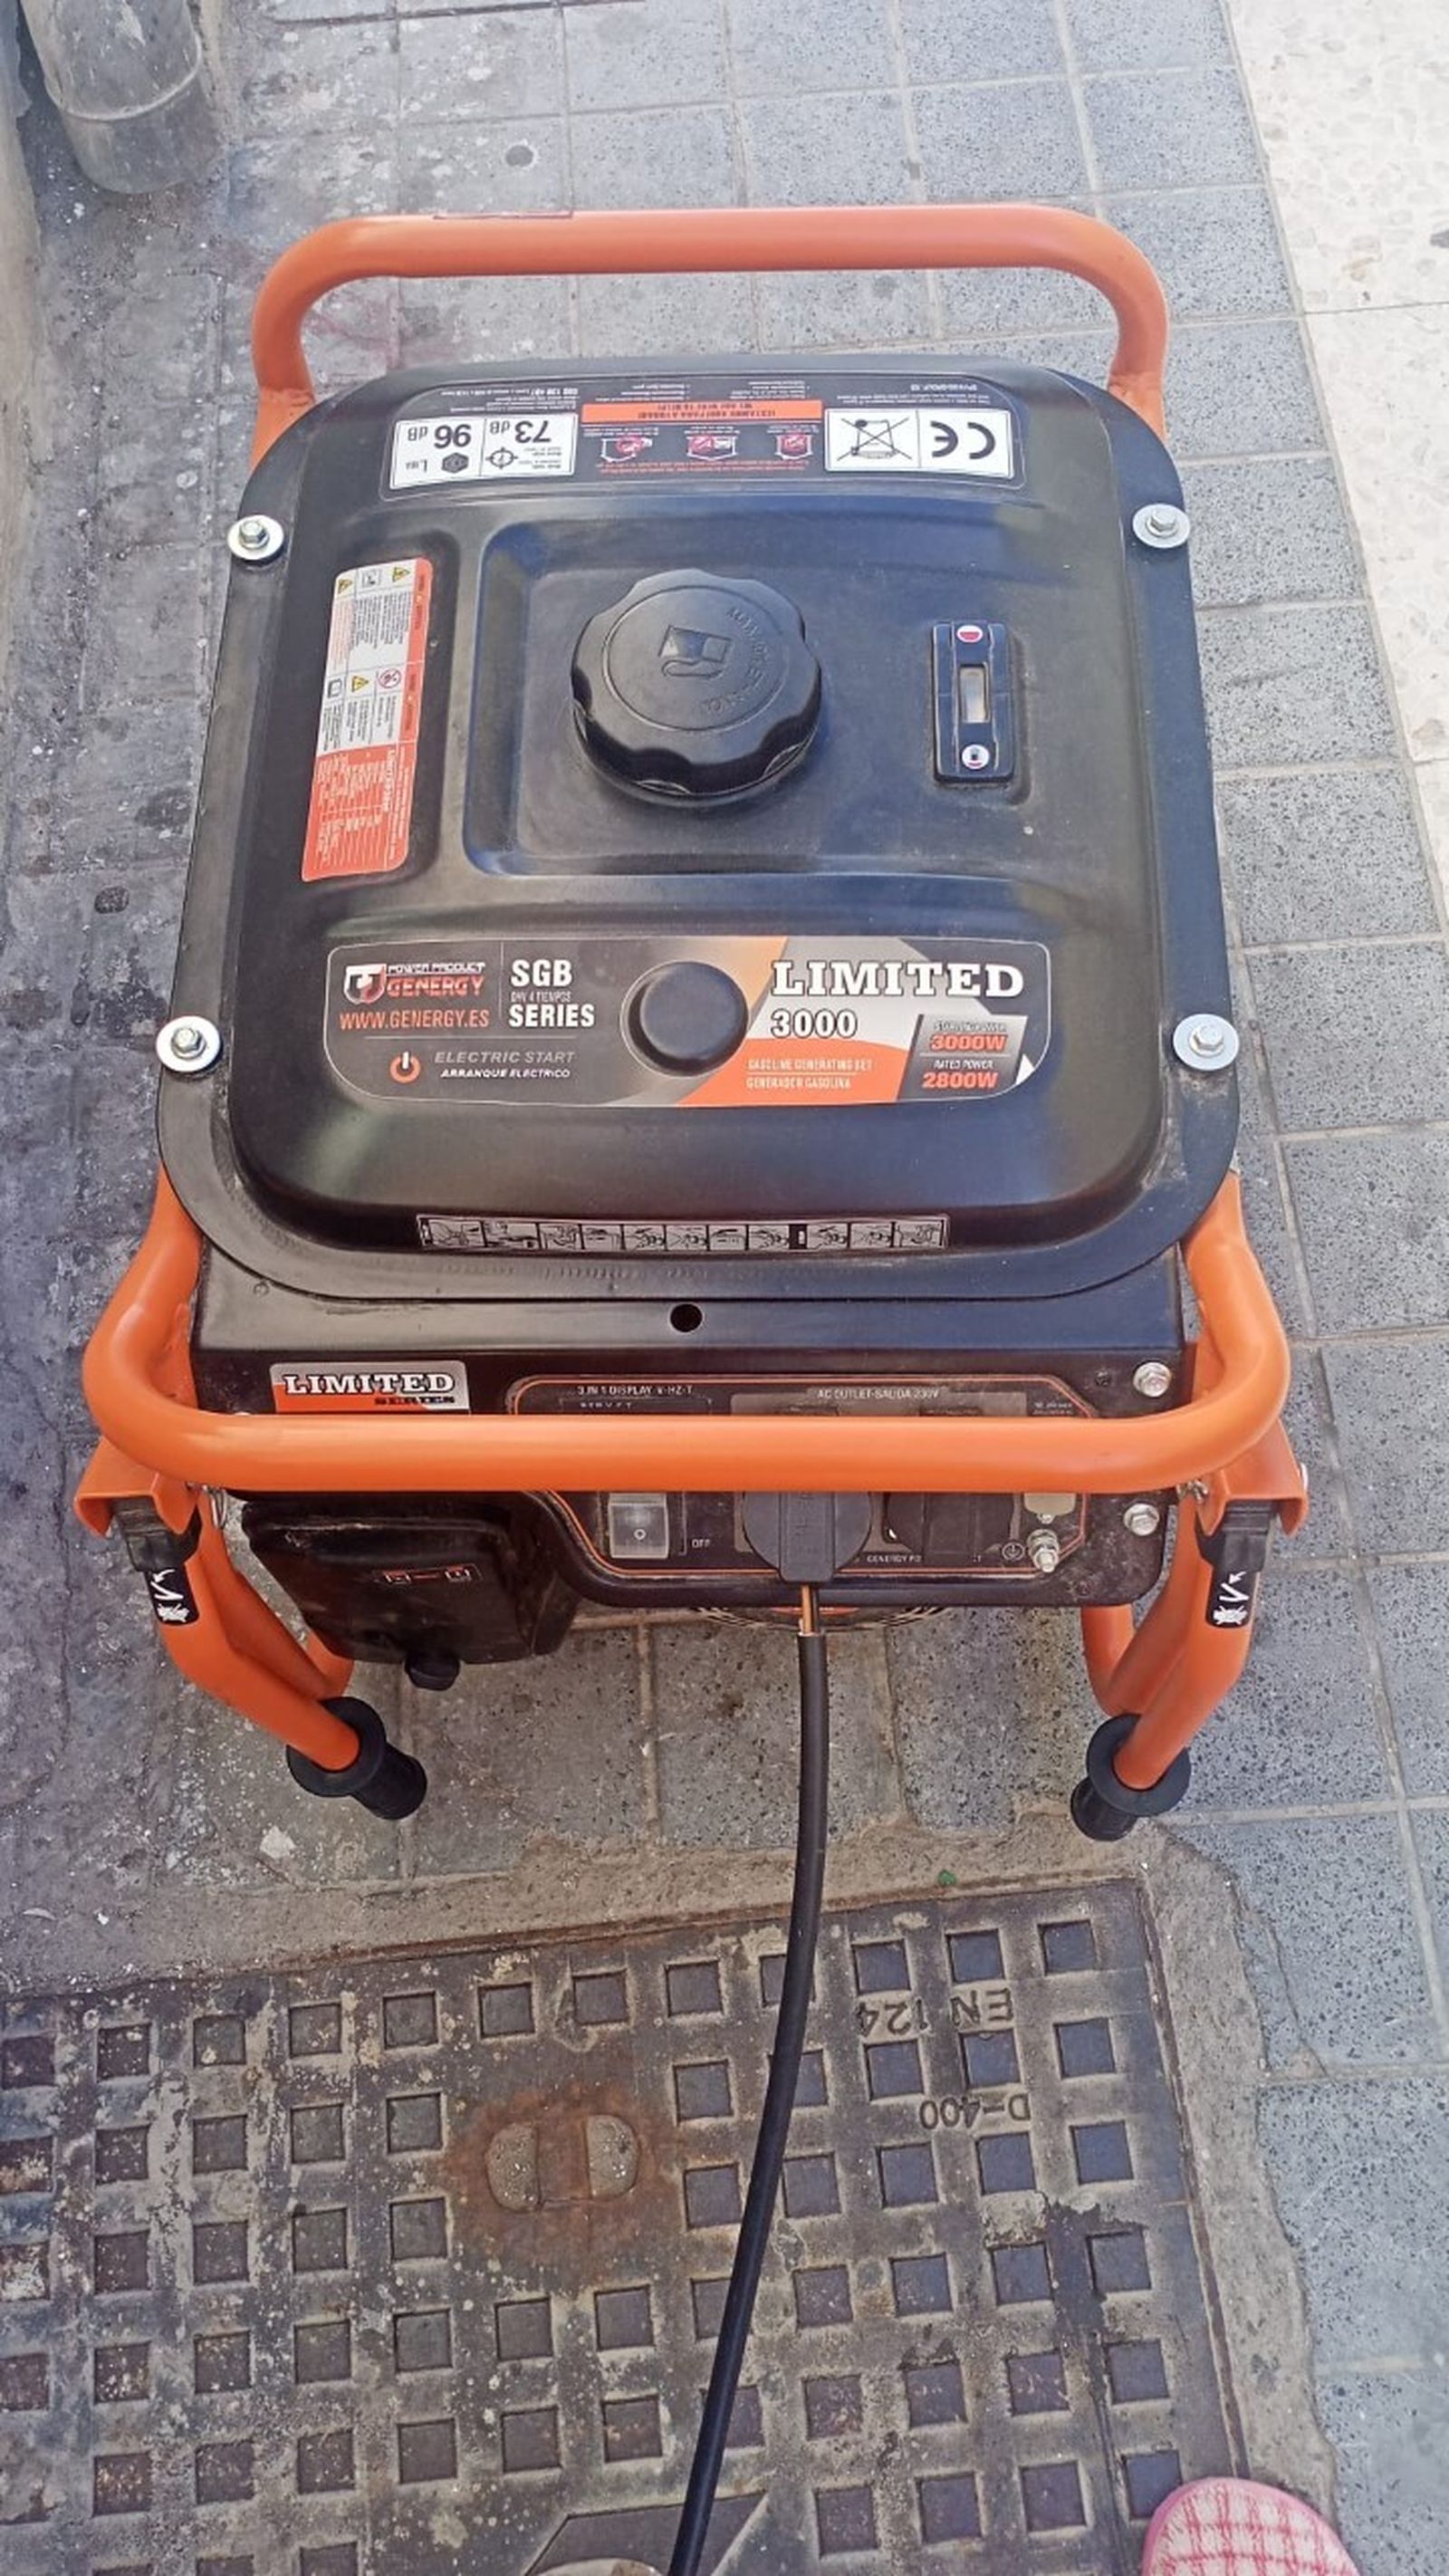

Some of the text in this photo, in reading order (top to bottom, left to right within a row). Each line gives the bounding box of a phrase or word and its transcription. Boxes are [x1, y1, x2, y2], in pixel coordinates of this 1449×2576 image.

[408, 424, 472, 448] 96 dB
[490, 420, 552, 444] 73 dB
[388, 962, 485, 974] POWER PRODUCT
[510, 958, 572, 987] SGB
[387, 976, 485, 997] GENERGY
[771, 960, 1025, 998] LIMITED
[340, 1009, 490, 1030] WWW.GENERGY.ES
[508, 1003, 595, 1028] SERIES
[771, 1009, 858, 1038] 3000
[930, 1033, 1008, 1052] 3000W
[434, 1051, 575, 1063] ELECTRIC START
[440, 1068, 508, 1078] ARRANQUE
[922, 1072, 999, 1089] 2800W
[284, 1373, 456, 1395] LIMITED
[608, 1385, 653, 1396] DISPLAY
[817, 1388, 832, 1399] AC
[856, 1987, 1014, 2038] EN 124
[919, 2092, 1032, 2129] D-400
